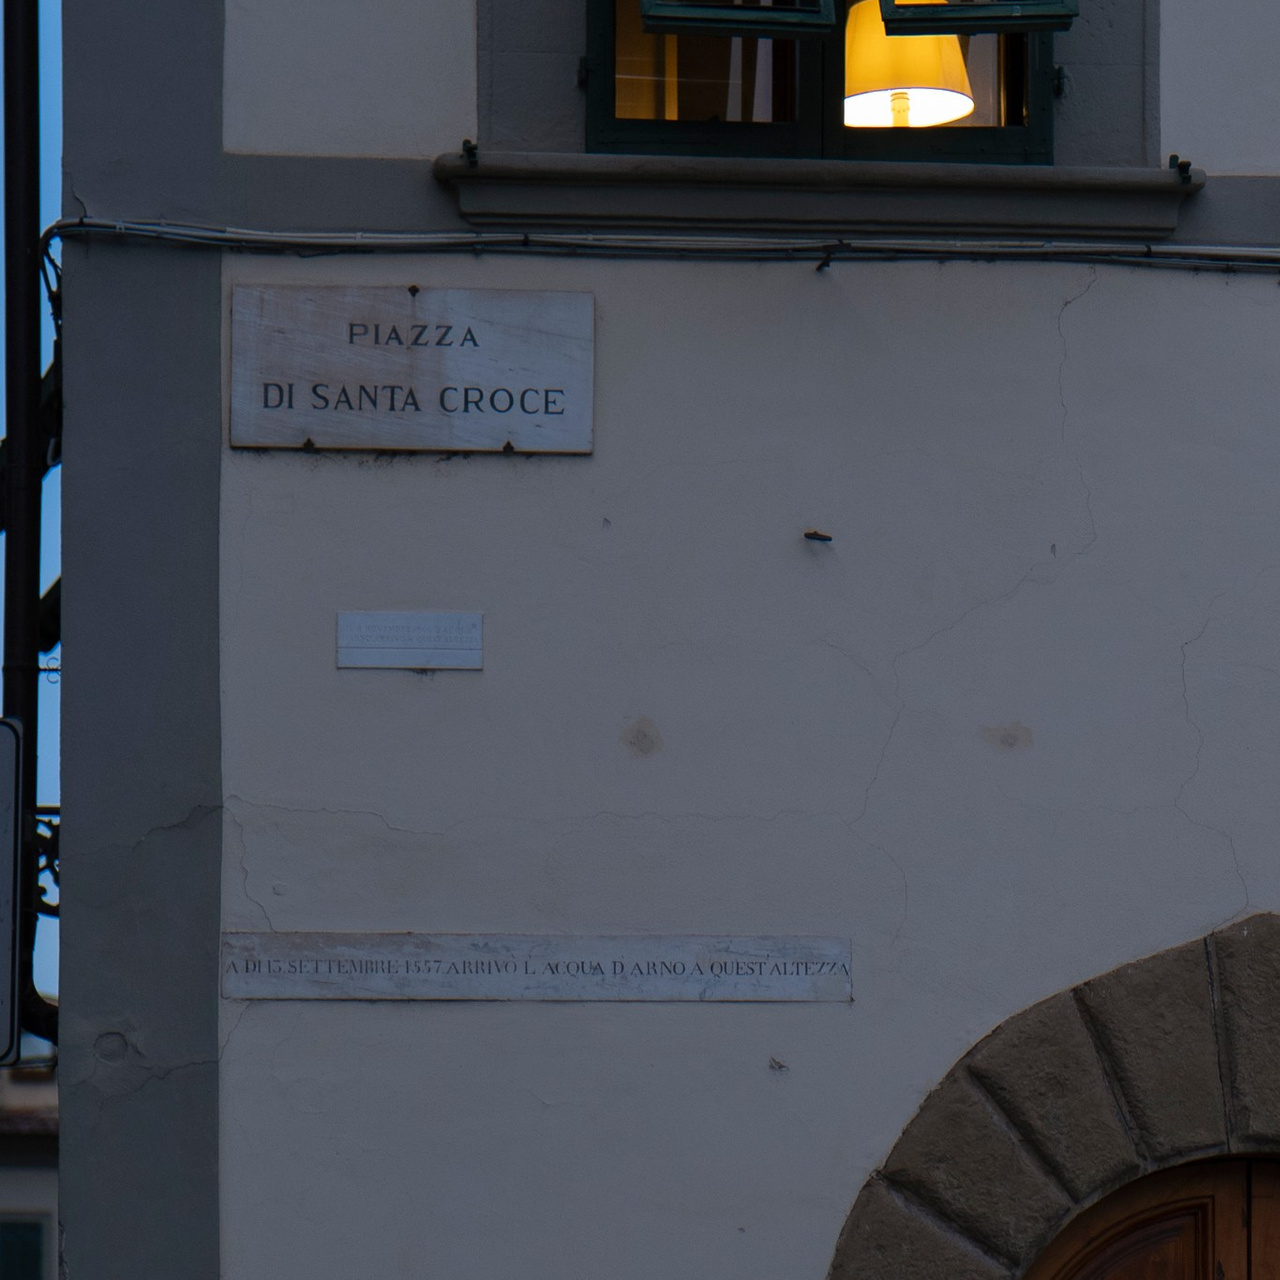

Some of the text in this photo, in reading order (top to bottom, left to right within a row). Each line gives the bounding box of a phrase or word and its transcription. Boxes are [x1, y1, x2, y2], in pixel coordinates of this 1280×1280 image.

[348, 323, 480, 347] PIAZZA
[263, 383, 565, 415] DI SANTA CROCE
[225, 960, 239, 974] A
[287, 959, 399, 974] SETTEMBRE
